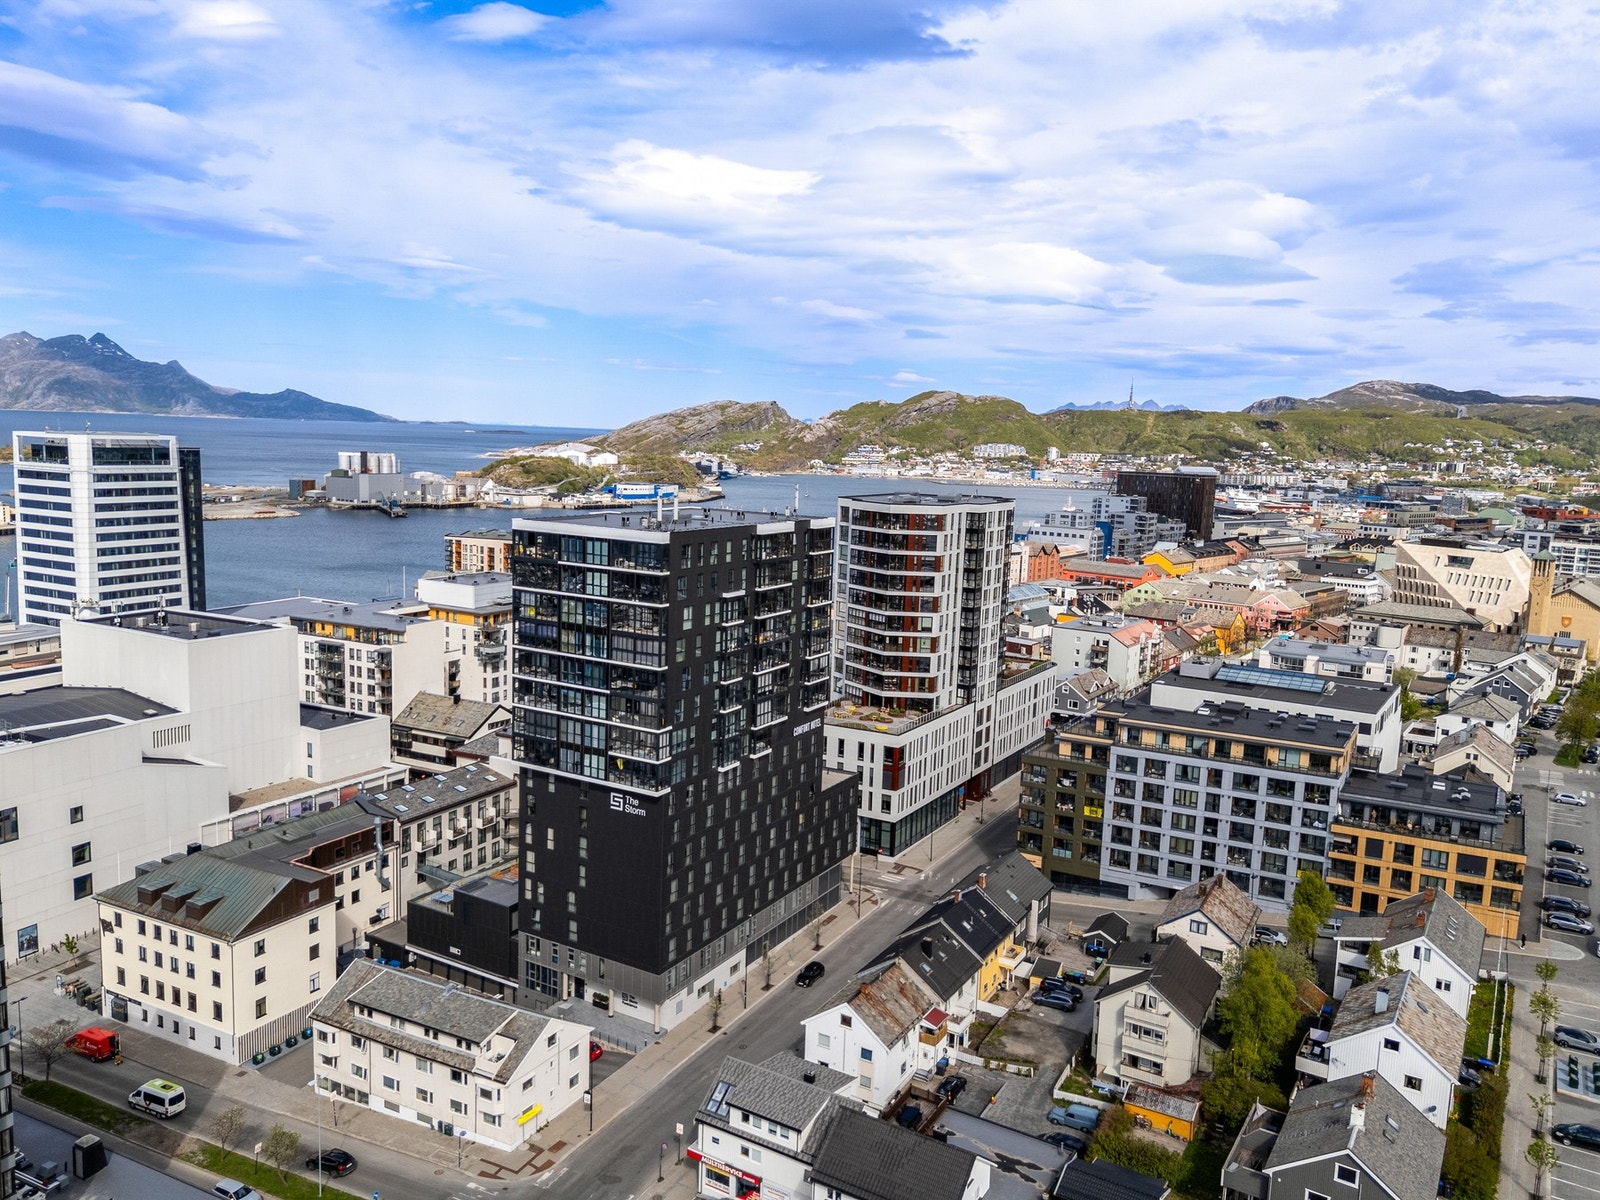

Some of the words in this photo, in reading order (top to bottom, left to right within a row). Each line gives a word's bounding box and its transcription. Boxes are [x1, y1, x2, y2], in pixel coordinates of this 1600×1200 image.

[624, 795, 639, 806] The
[624, 804, 646, 817] Storm
[701, 1156, 743, 1178] MULTISERVICE
